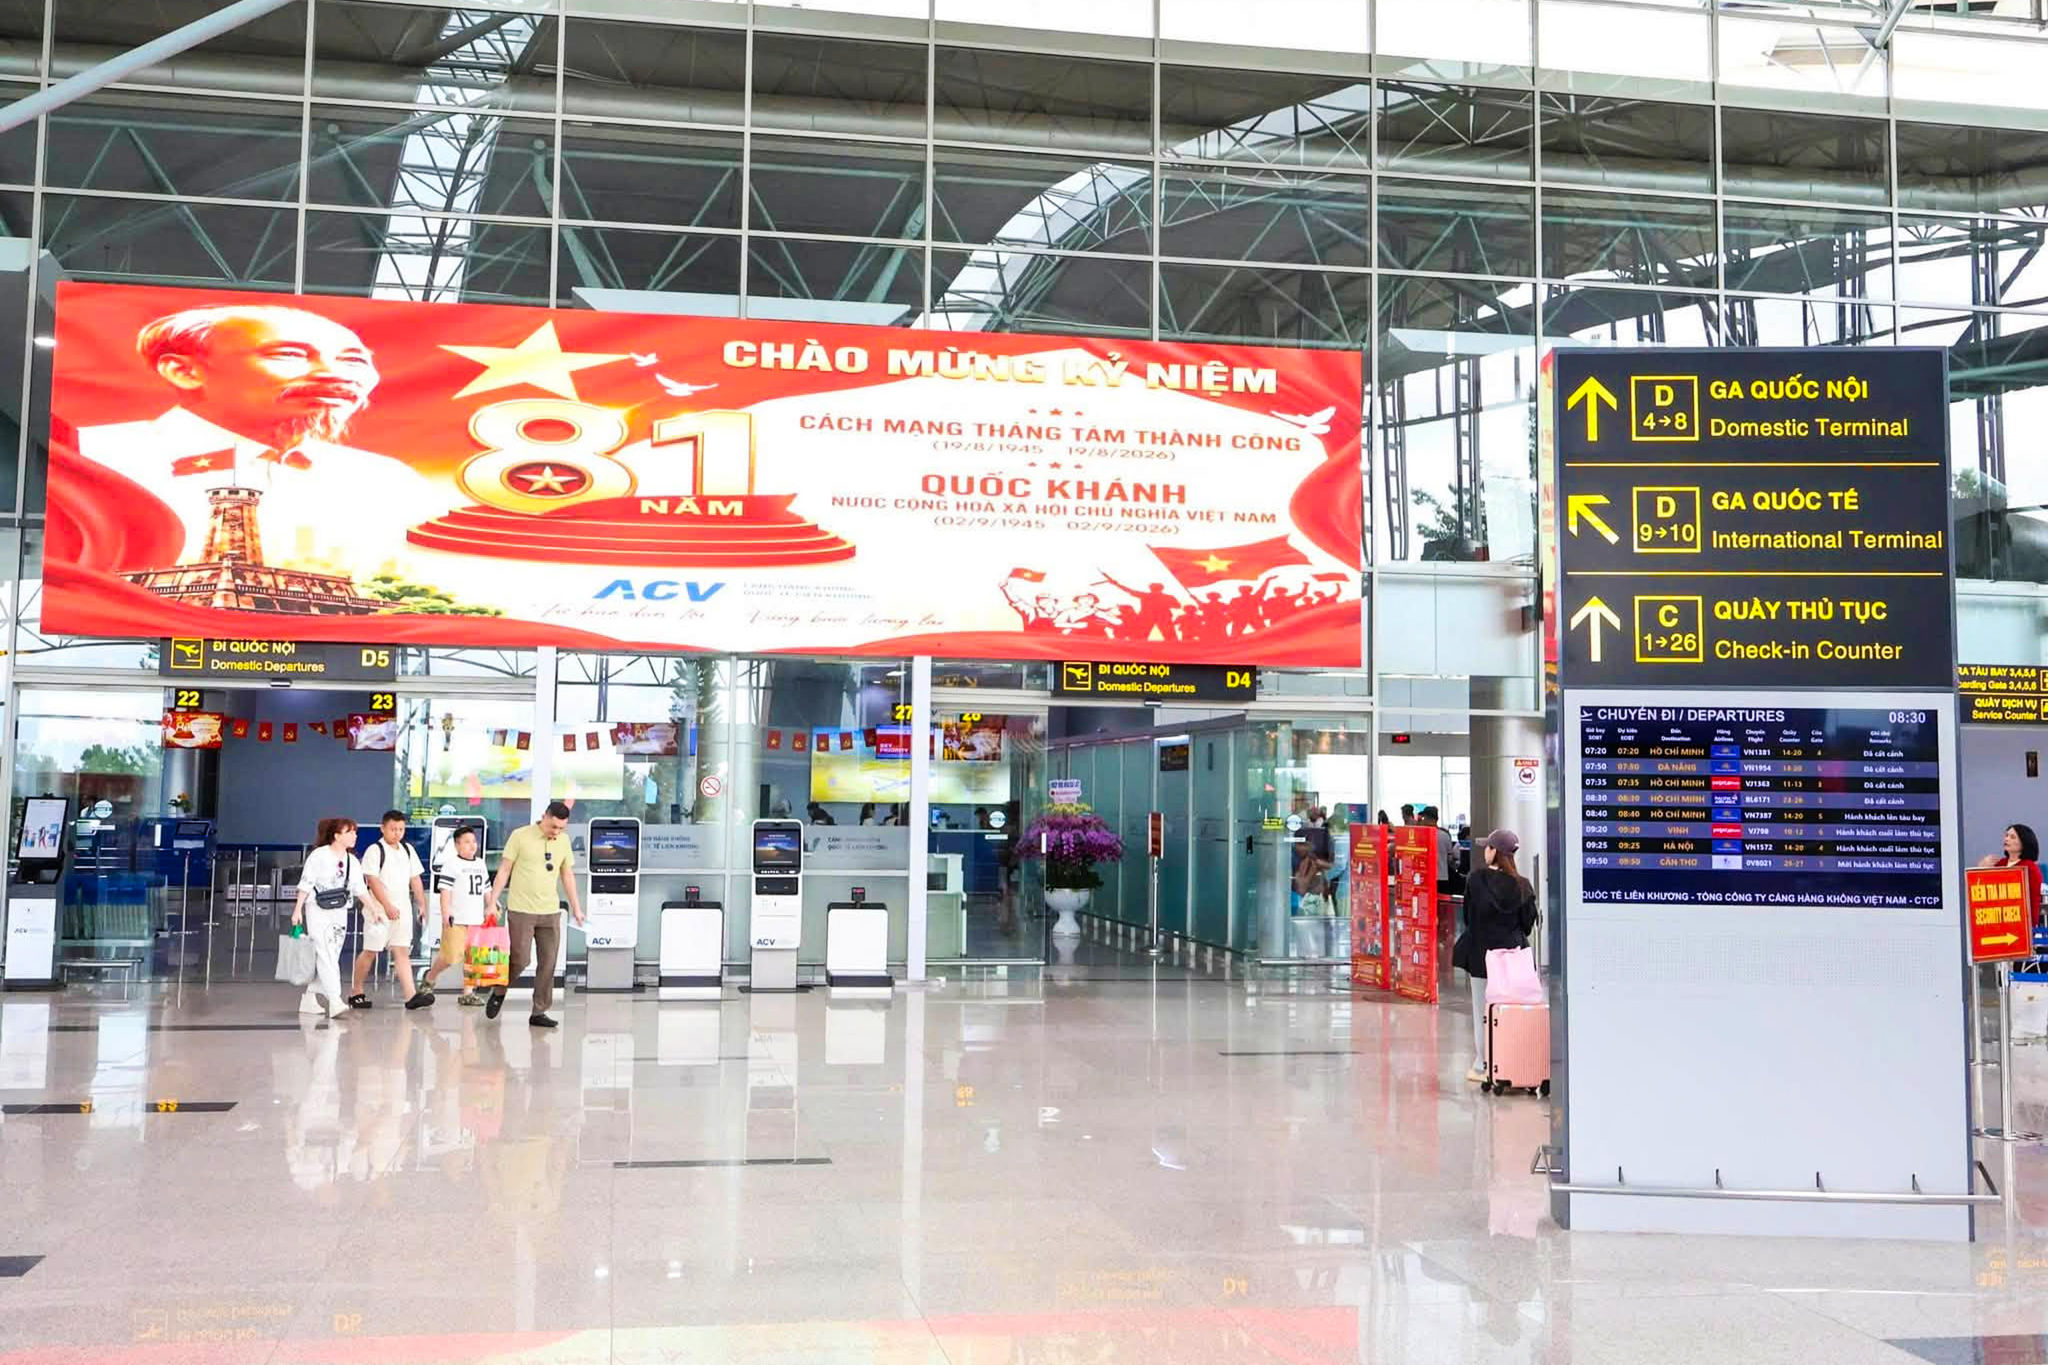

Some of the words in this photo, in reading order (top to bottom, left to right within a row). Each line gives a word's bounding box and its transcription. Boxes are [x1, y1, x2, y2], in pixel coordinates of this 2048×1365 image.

[723, 338, 869, 374] CHÀO
[887, 346, 1046, 383] MỪNG
[1063, 351, 1129, 387] KỶ
[1146, 360, 1277, 397] NIỆM
[1655, 385, 1674, 406] D
[1710, 381, 1743, 399] GA
[1751, 373, 1819, 399] QUỐC
[1827, 376, 1868, 402] NỘI
[800, 413, 873, 432] CÁCH
[884, 418, 963, 437] MẠNG
[976, 422, 1062, 441] THÁNG
[1072, 426, 1125, 444] TÁM
[1136, 429, 1221, 448] THÀNH
[1231, 432, 1301, 451] CÔNG
[1710, 418, 1809, 436] Domestic
[1815, 418, 1908, 436] Terminal
[455, 398, 758, 518] 81
[921, 471, 1031, 498] QUỐC
[1047, 477, 1187, 505] KHÁNH
[640, 497, 744, 516] NĂM
[1657, 496, 1676, 517] D
[1711, 492, 1746, 510] GA
[1753, 488, 1821, 510] QUỐC
[1828, 488, 1859, 509] TẾ
[1186, 509, 1225, 523] VIỆT
[1234, 512, 1276, 523] NAM
[1712, 530, 1842, 549] International
[1849, 530, 1943, 548] Terminal
[592, 579, 727, 602] ACV
[1658, 605, 1679, 628] C
[1714, 597, 1781, 620] QUẦY
[1787, 597, 1833, 620] THỦ
[1839, 601, 1887, 624] TỤC
[212, 641, 227, 652] ĐI
[272, 641, 296, 656] NỘI
[1714, 640, 1810, 660] Check-in
[1817, 641, 1903, 660] Counter
[211, 659, 263, 671] Domestic
[264, 661, 325, 673] Departures
[361, 649, 390, 668] D5
[1098, 664, 1110, 675] ĐI
[1149, 665, 1170, 678] NỘI
[1970, 666, 1988, 676] TÀU
[1990, 667, 2008, 677] BAY
[2009, 668, 2037, 678] 3,4,5,6
[1098, 681, 1142, 692] Domestic
[1144, 682, 1196, 693] Departures
[1226, 671, 1251, 688] D4
[1957, 681, 1987, 691] oarding
[1988, 681, 2007, 690] Gate
[2008, 681, 2037, 691] 3,4,5,6
[177, 691, 200, 707] 22
[371, 694, 394, 710] 23
[2002, 699, 2024, 709] DỊCH
[2024, 699, 2038, 710] VỤ
[895, 705, 913, 720] 27
[1597, 706, 1657, 721] CHUYẾN
[1661, 709, 1675, 721] ĐI
[1687, 709, 1785, 722] DEPARTURES
[1888, 711, 1926, 724] 08:30
[1972, 710, 2003, 720] Service
[2004, 711, 2038, 720] Counter
[1584, 747, 1607, 755] 07:20
[1617, 747, 1640, 755] 07:20
[1649, 746, 1662, 755] HỒ
[1664, 746, 1679, 755] CHÍ
[1585, 778, 1607, 786] 07:35
[1650, 778, 1663, 787] HỒ
[1664, 778, 1680, 787] CHÍ
[1681, 779, 1705, 787] MINH
[1650, 794, 1663, 803] HỒ
[1665, 794, 1680, 803] CHÍ
[1681, 795, 1705, 803] MINH
[1585, 810, 1608, 818] 08:40
[1618, 810, 1640, 818] 08:40
[1650, 809, 1663, 818] HỒ
[1665, 809, 1680, 818] CHÍ
[1681, 811, 1706, 819] MINH
[1667, 826, 1689, 835] VINH
[1586, 841, 1608, 849] 09:25
[1663, 841, 1676, 850] HÀ
[1677, 841, 1694, 852] NỘI
[1586, 857, 1608, 865] 09:50
[468, 874, 483, 895] 12
[1624, 890, 1645, 900] LIÊN
[1647, 891, 1689, 901] KHƯƠNG
[1725, 891, 1753, 902] CÔNG
[1755, 893, 1767, 903] TY
[1798, 892, 1824, 903] HÀNG
[1827, 892, 1860, 904] KHÔNG
[1862, 893, 1884, 905] VIỆT
[1885, 895, 1907, 904] NAM
[1914, 896, 1940, 905] CTCP
[1975, 907, 2002, 925] SECURITY
[2002, 905, 2021, 922] CHECK
[592, 937, 611, 945] ACV
[756, 938, 776, 946] ACV
